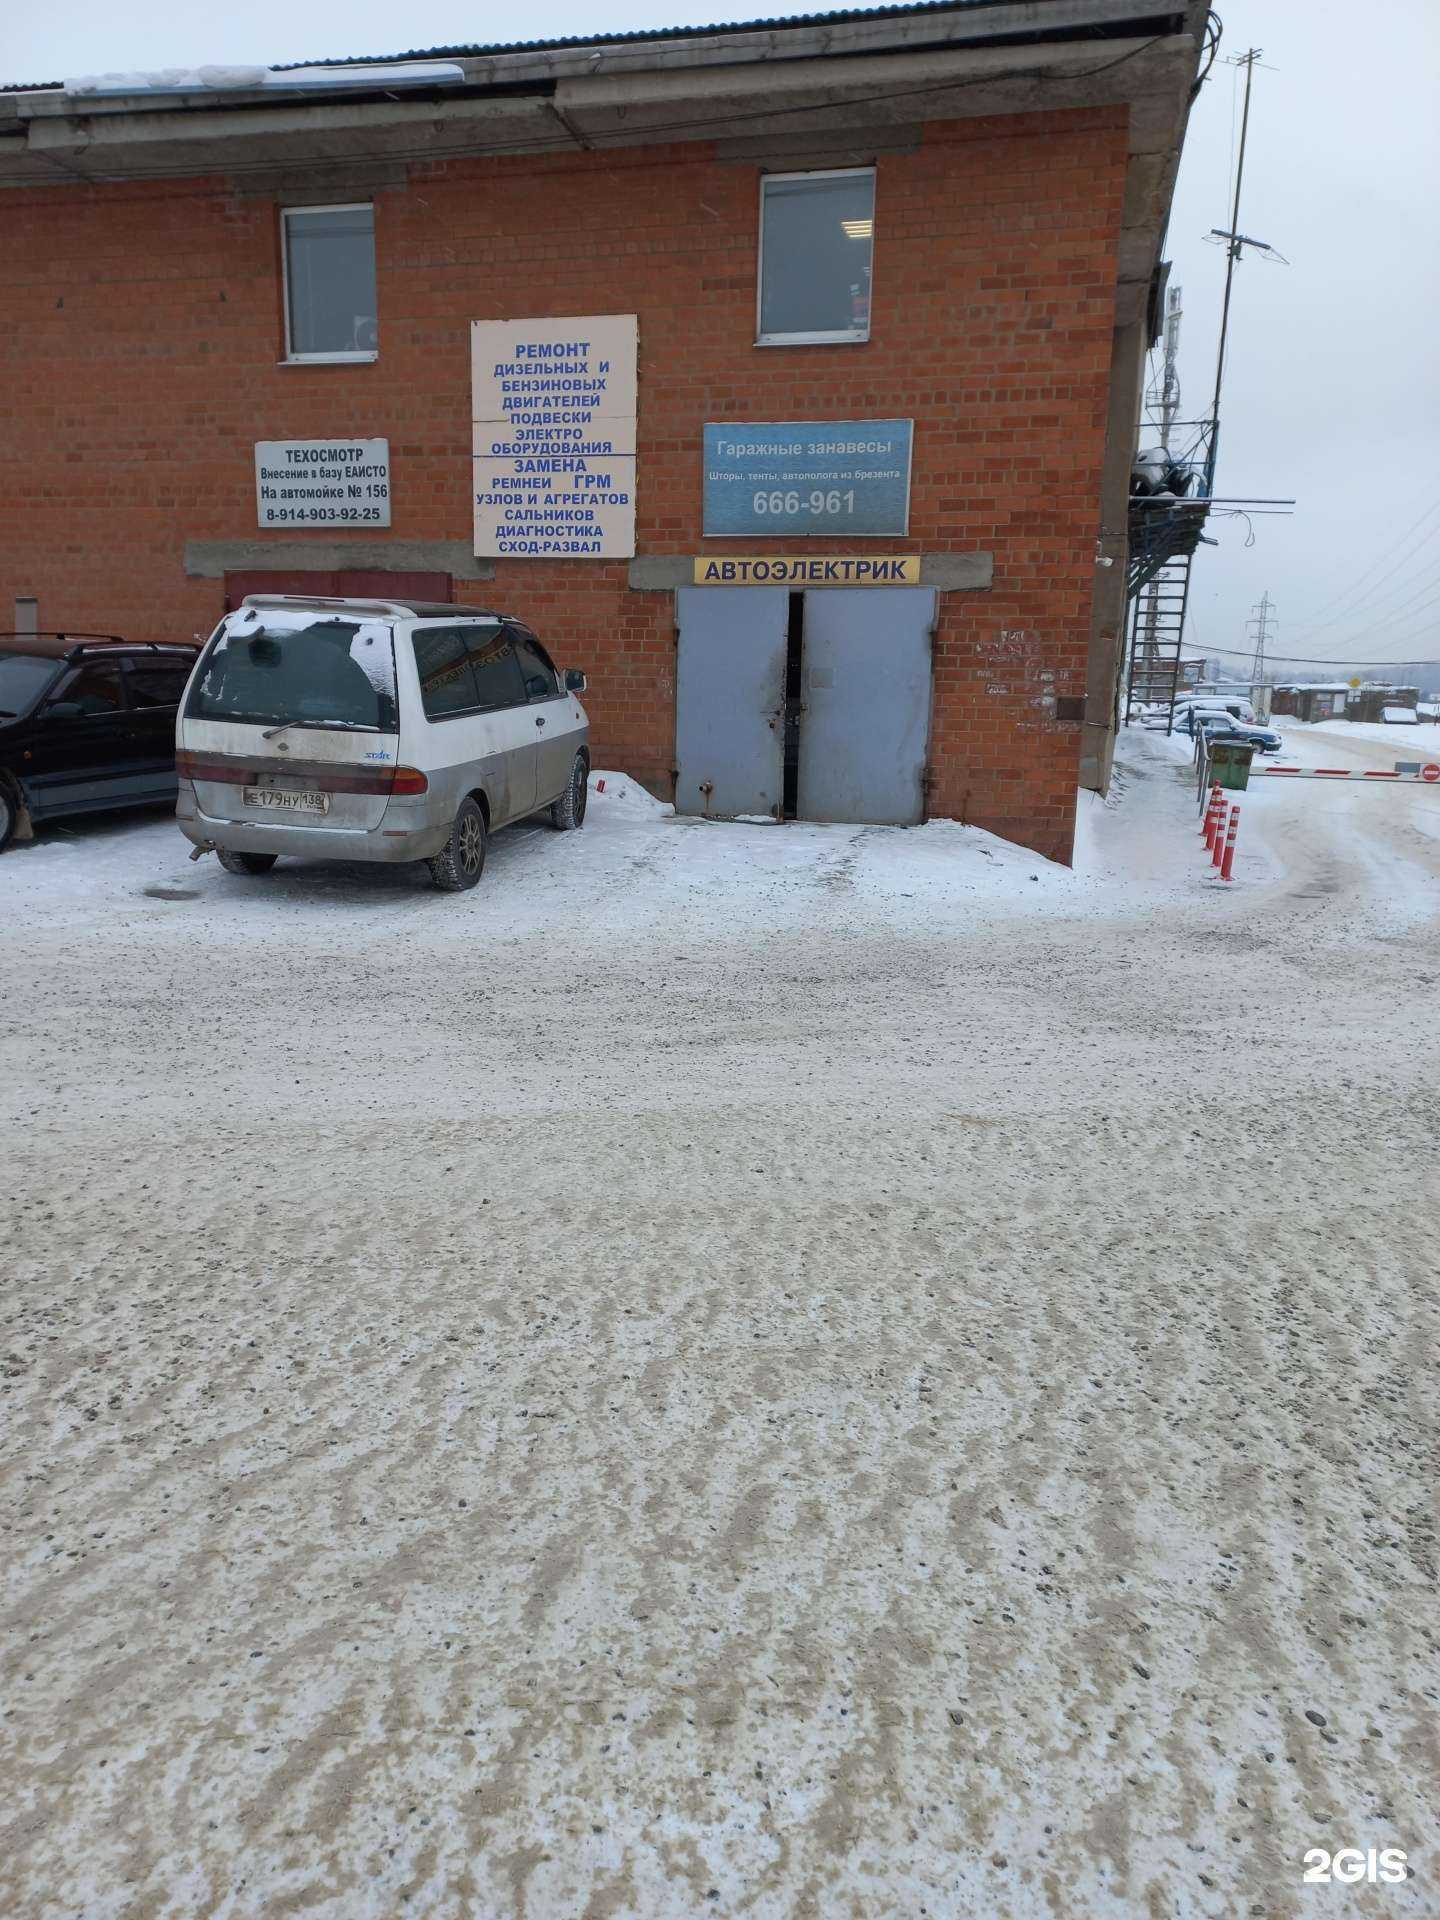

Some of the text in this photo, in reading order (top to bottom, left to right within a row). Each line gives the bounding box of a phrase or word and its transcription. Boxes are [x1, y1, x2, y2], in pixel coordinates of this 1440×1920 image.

[515, 343, 590, 358] РЕМОНТ
[494, 361, 610, 377] ДИЗЕЛЬНЫХ И
[502, 378, 606, 392] БЕНЗИНОВЫХ
[502, 393, 600, 410] ДВИГАТЕЛЕЙ
[510, 412, 592, 426] ПОДВЕСКИ
[515, 429, 583, 440] ЭЛЕКТРО
[285, 448, 363, 463] ТЕХОСМОТР
[491, 442, 612, 456] ОБОРУДОВАНИЯ
[716, 439, 892, 458] Гаражные занавесы
[261, 465, 386, 480] Внесение в базу ЕАИСТО
[514, 458, 587, 473] ЗАМЕНА
[574, 474, 611, 489] ГРМ
[709, 469, 900, 482] Шторы, тенты, автополога из брезента
[261, 484, 388, 499] На автомойке № 156
[476, 493, 629, 505] УЗЛОВ И АГРЕГАТОВ
[753, 489, 855, 514] 666-961
[266, 508, 381, 521] 8-914-903-92-25
[504, 509, 594, 521] САЛЬНИКОВ
[495, 525, 604, 539] ДИАГНОСТИКА
[499, 541, 601, 554] СХОД-РАЗВАЛ
[704, 559, 907, 581] АВТОЭЛЕКТРИК
